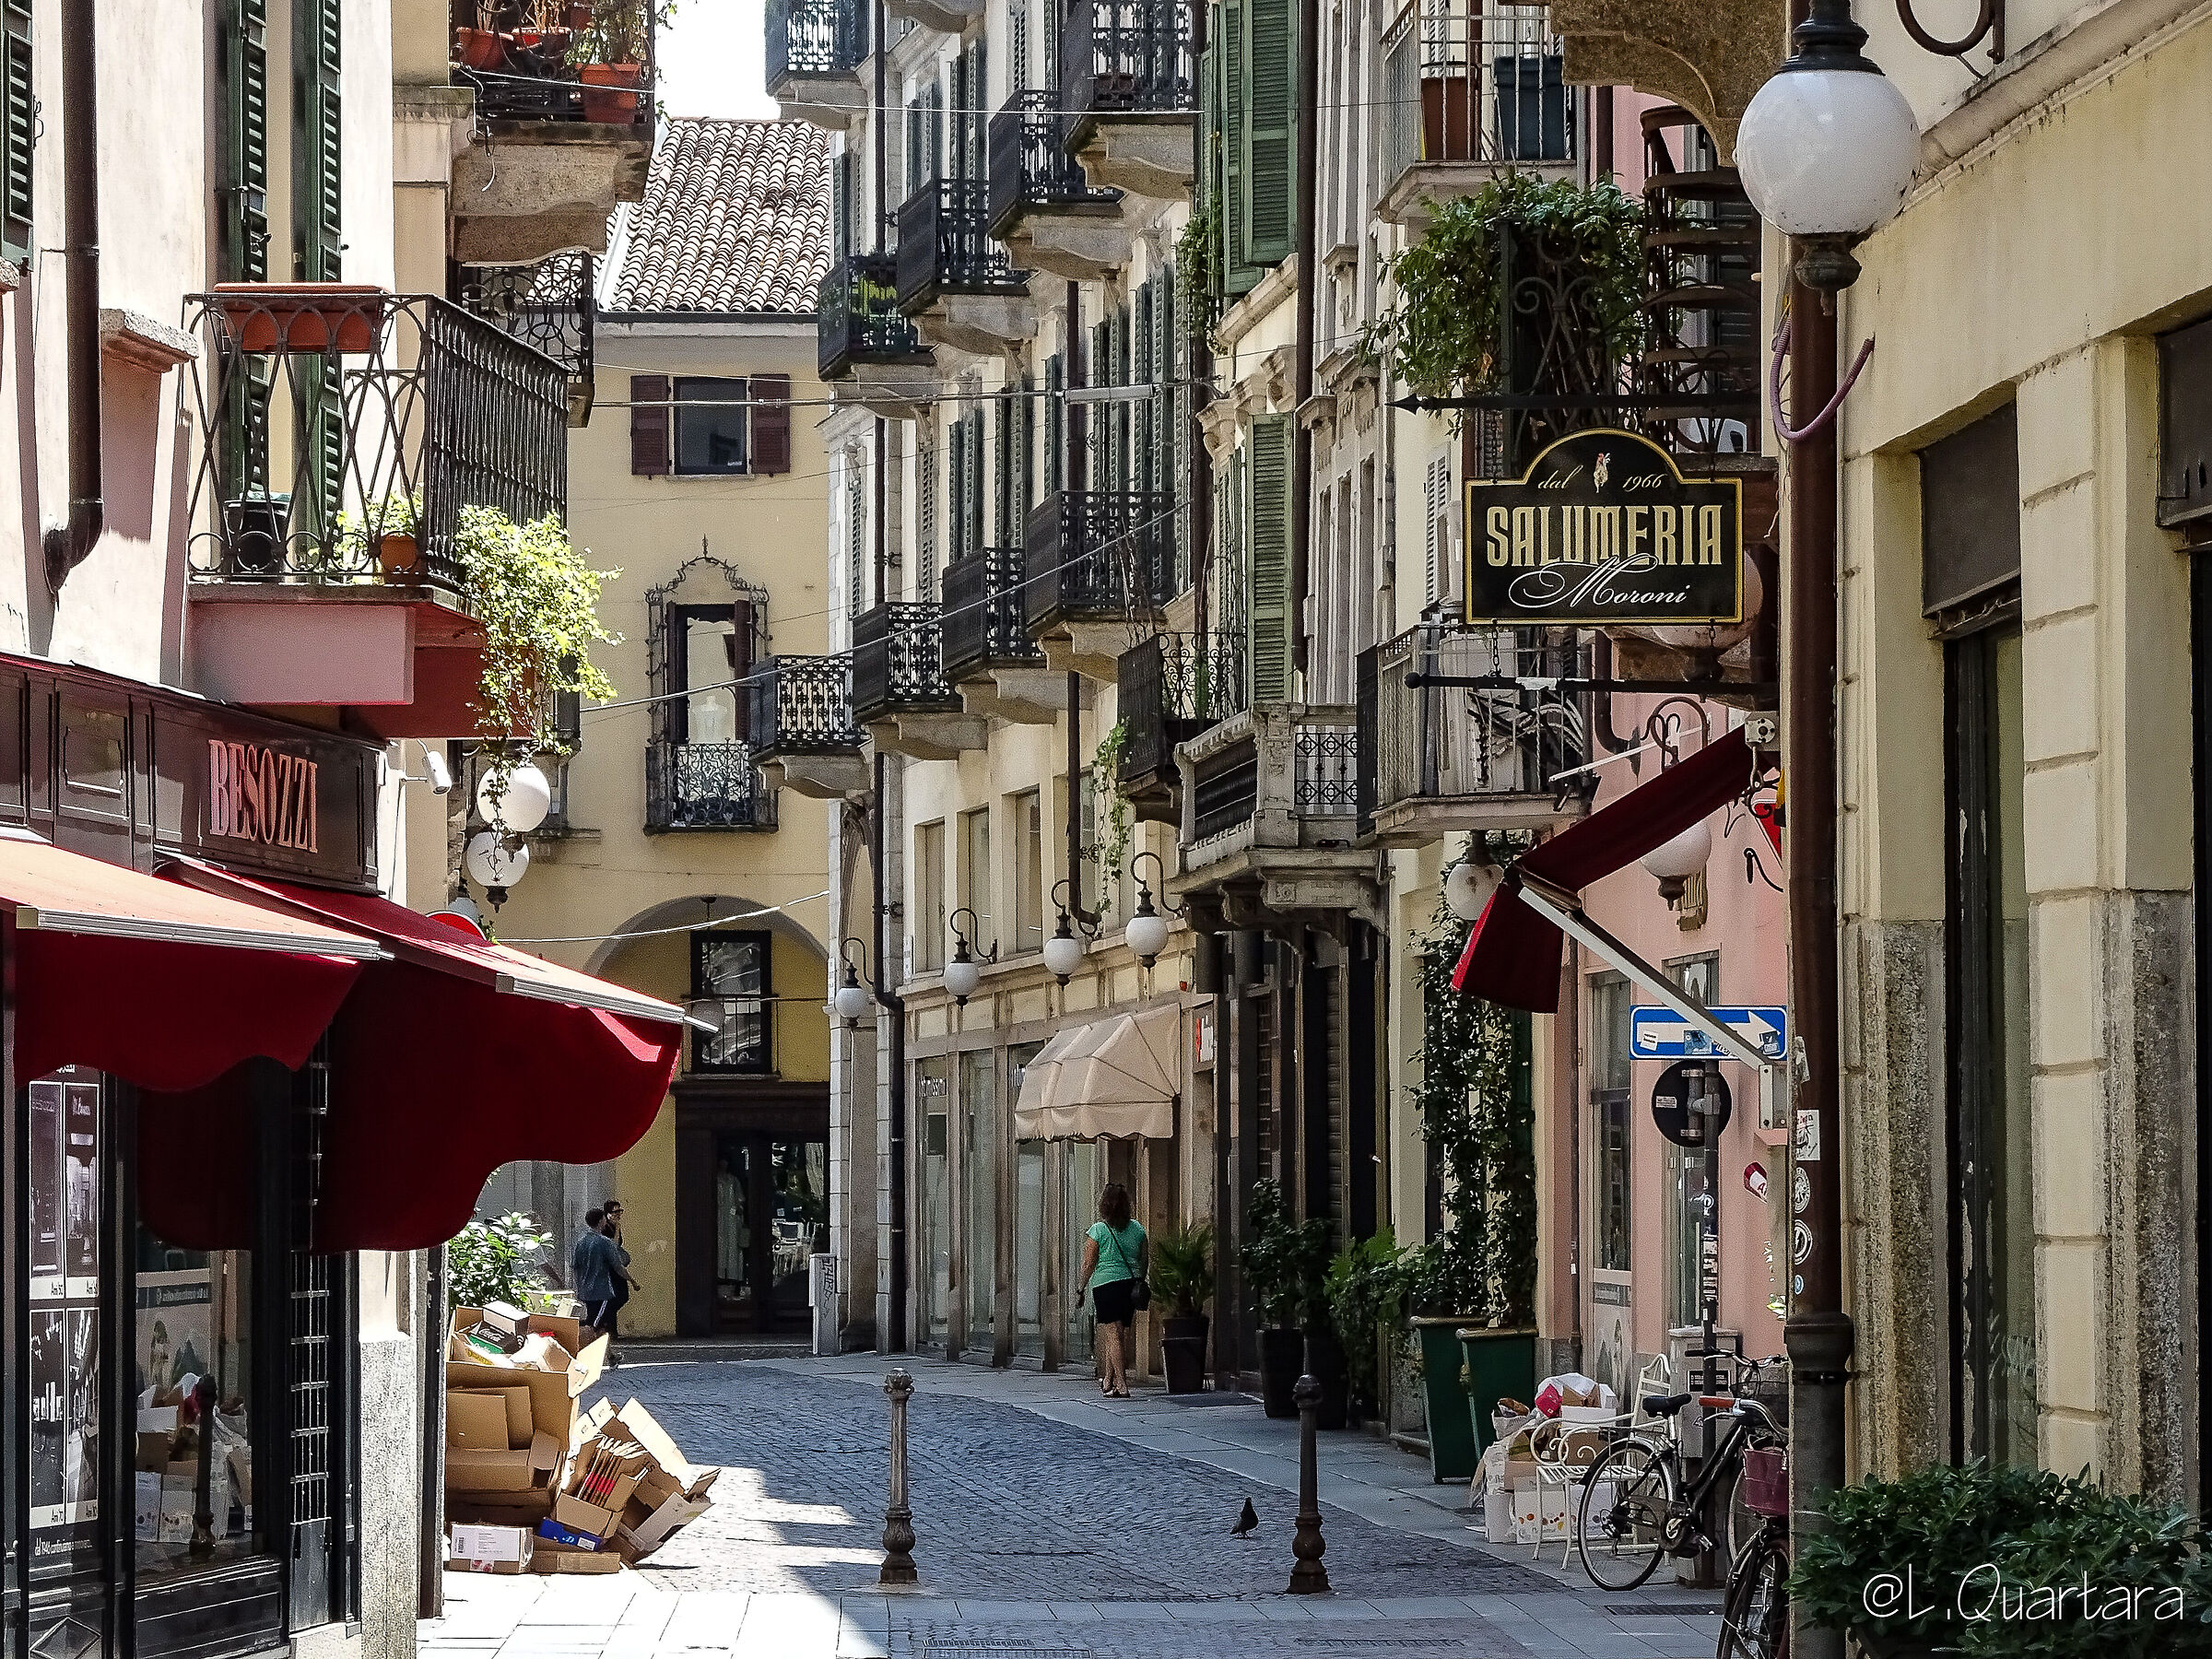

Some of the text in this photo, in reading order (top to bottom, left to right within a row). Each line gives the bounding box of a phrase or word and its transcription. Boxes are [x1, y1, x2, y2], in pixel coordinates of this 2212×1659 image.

[1537, 465, 1668, 492] dal 1966
[1486, 504, 1723, 567] SALUMERIA
[1508, 552, 1690, 608] Moroni
[208, 738, 318, 853] BESOZZI
